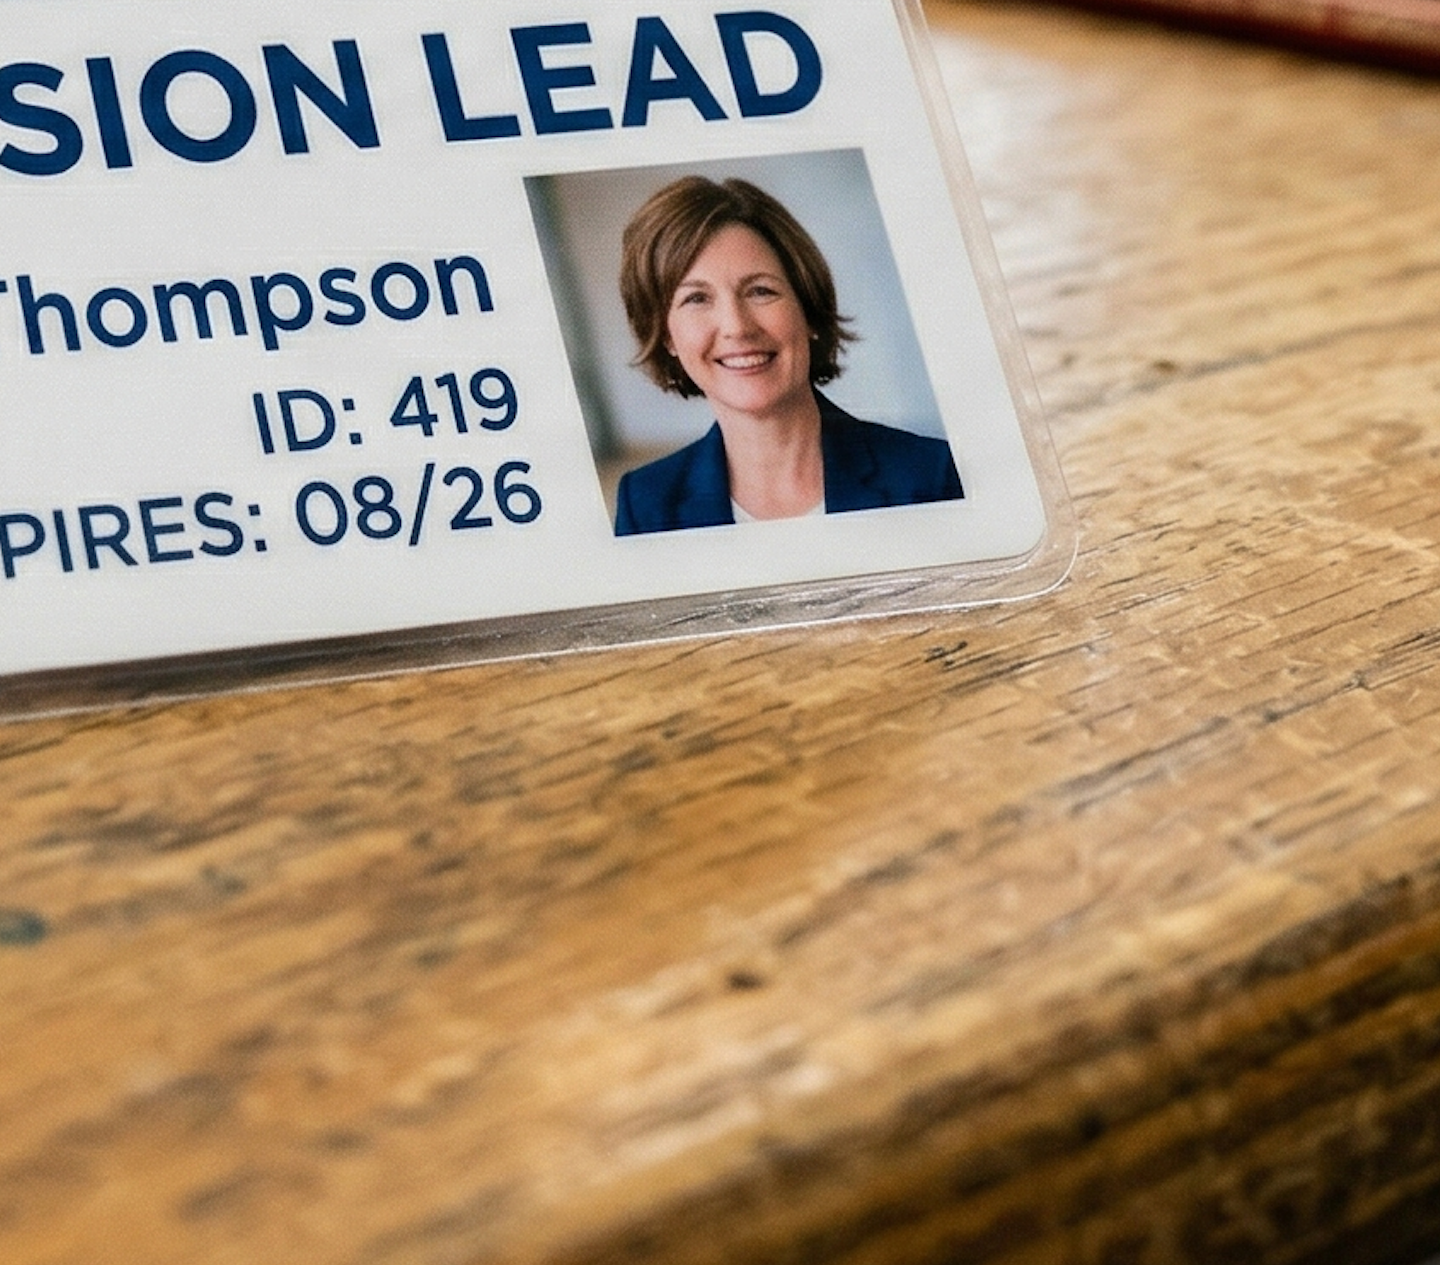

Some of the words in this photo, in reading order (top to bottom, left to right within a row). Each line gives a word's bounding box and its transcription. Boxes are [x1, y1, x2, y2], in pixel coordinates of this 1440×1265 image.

[421, 10, 823, 147] LEAD
[252, 390, 360, 455] ID:
[389, 367, 519, 438] 419
[295, 461, 543, 551] 08/26
